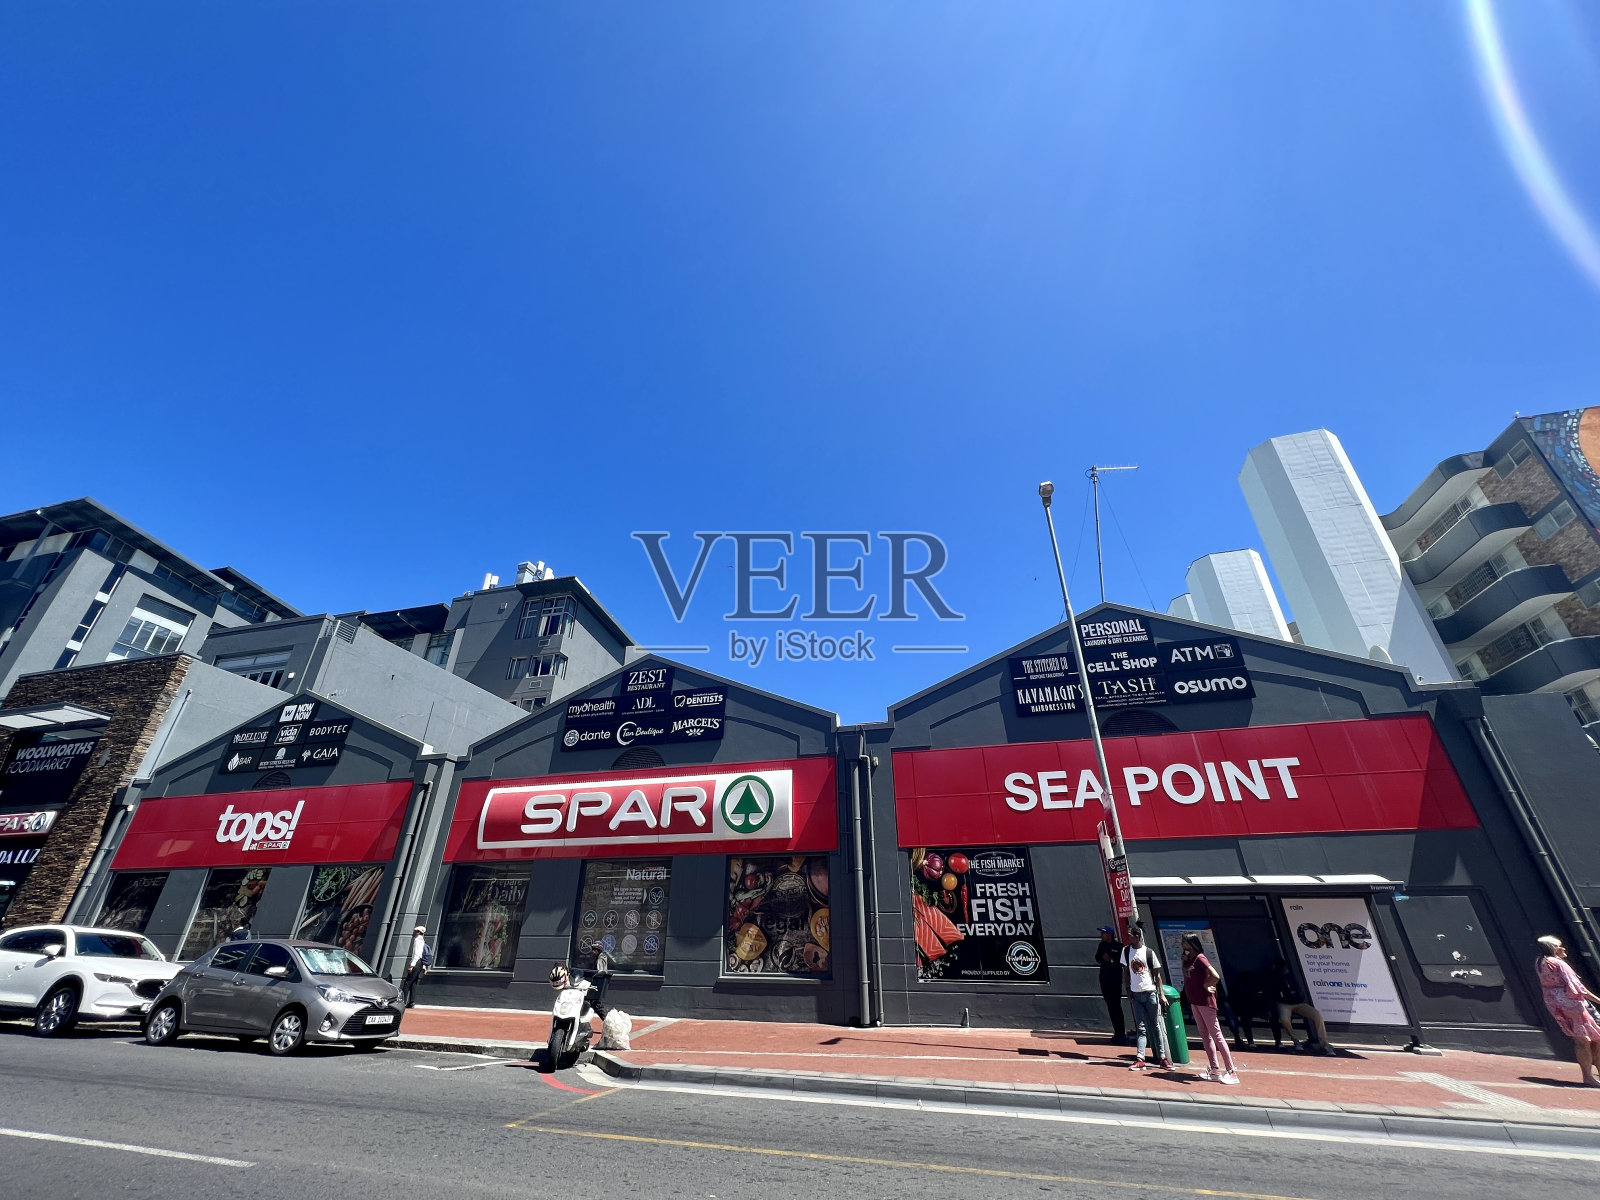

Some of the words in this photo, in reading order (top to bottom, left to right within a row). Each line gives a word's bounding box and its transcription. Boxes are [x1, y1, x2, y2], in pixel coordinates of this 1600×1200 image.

[1080, 618, 1146, 638] PERSONAL
[1084, 638, 1106, 647] LAUNDRY
[1107, 638, 1112, 646] &
[1112, 636, 1122, 644] DRY
[1124, 634, 1149, 643] CLEANING
[1111, 652, 1128, 660] THE
[1170, 646, 1214, 664] ATM
[1022, 660, 1034, 674] THE
[1086, 661, 1120, 673] CELL
[1122, 657, 1158, 670] SHOP
[628, 669, 667, 684] ZEST
[626, 682, 666, 692] RESTAURANT
[1098, 678, 1155, 695] TASH
[1174, 676, 1247, 694] osumo
[632, 696, 656, 710] ADL
[686, 694, 724, 705] DENTISTS
[298, 702, 315, 712] NOW
[1031, 702, 1076, 713] HAIRDRESSING
[294, 710, 312, 720] NOW
[280, 726, 298, 737] vida
[309, 724, 349, 737] BODYTEC
[622, 728, 634, 738] Tan
[636, 727, 664, 738] Boutique
[670, 718, 721, 733] MARCEL'S
[240, 732, 270, 740] DELUXE
[580, 730, 611, 741] dante
[16, 742, 94, 760] WOOLWORTHS
[312, 748, 338, 760] GAIA
[6, 756, 75, 774] FOODMARKET
[1004, 768, 1105, 812] SEA
[1123, 757, 1300, 806] POINT
[520, 786, 708, 835] SPAR
[216, 800, 306, 851] tops!
[262, 841, 282, 849] SPAR
[14, 848, 41, 864] LUZ
[980, 860, 996, 868] FISH
[997, 858, 1024, 868] MARKET
[626, 868, 667, 881] Natural
[488, 885, 527, 904] Daily
[976, 882, 1030, 896] FRESH
[971, 898, 1034, 922] FISH
[957, 923, 1034, 936] EVERYDAY
[1296, 922, 1372, 950] one
